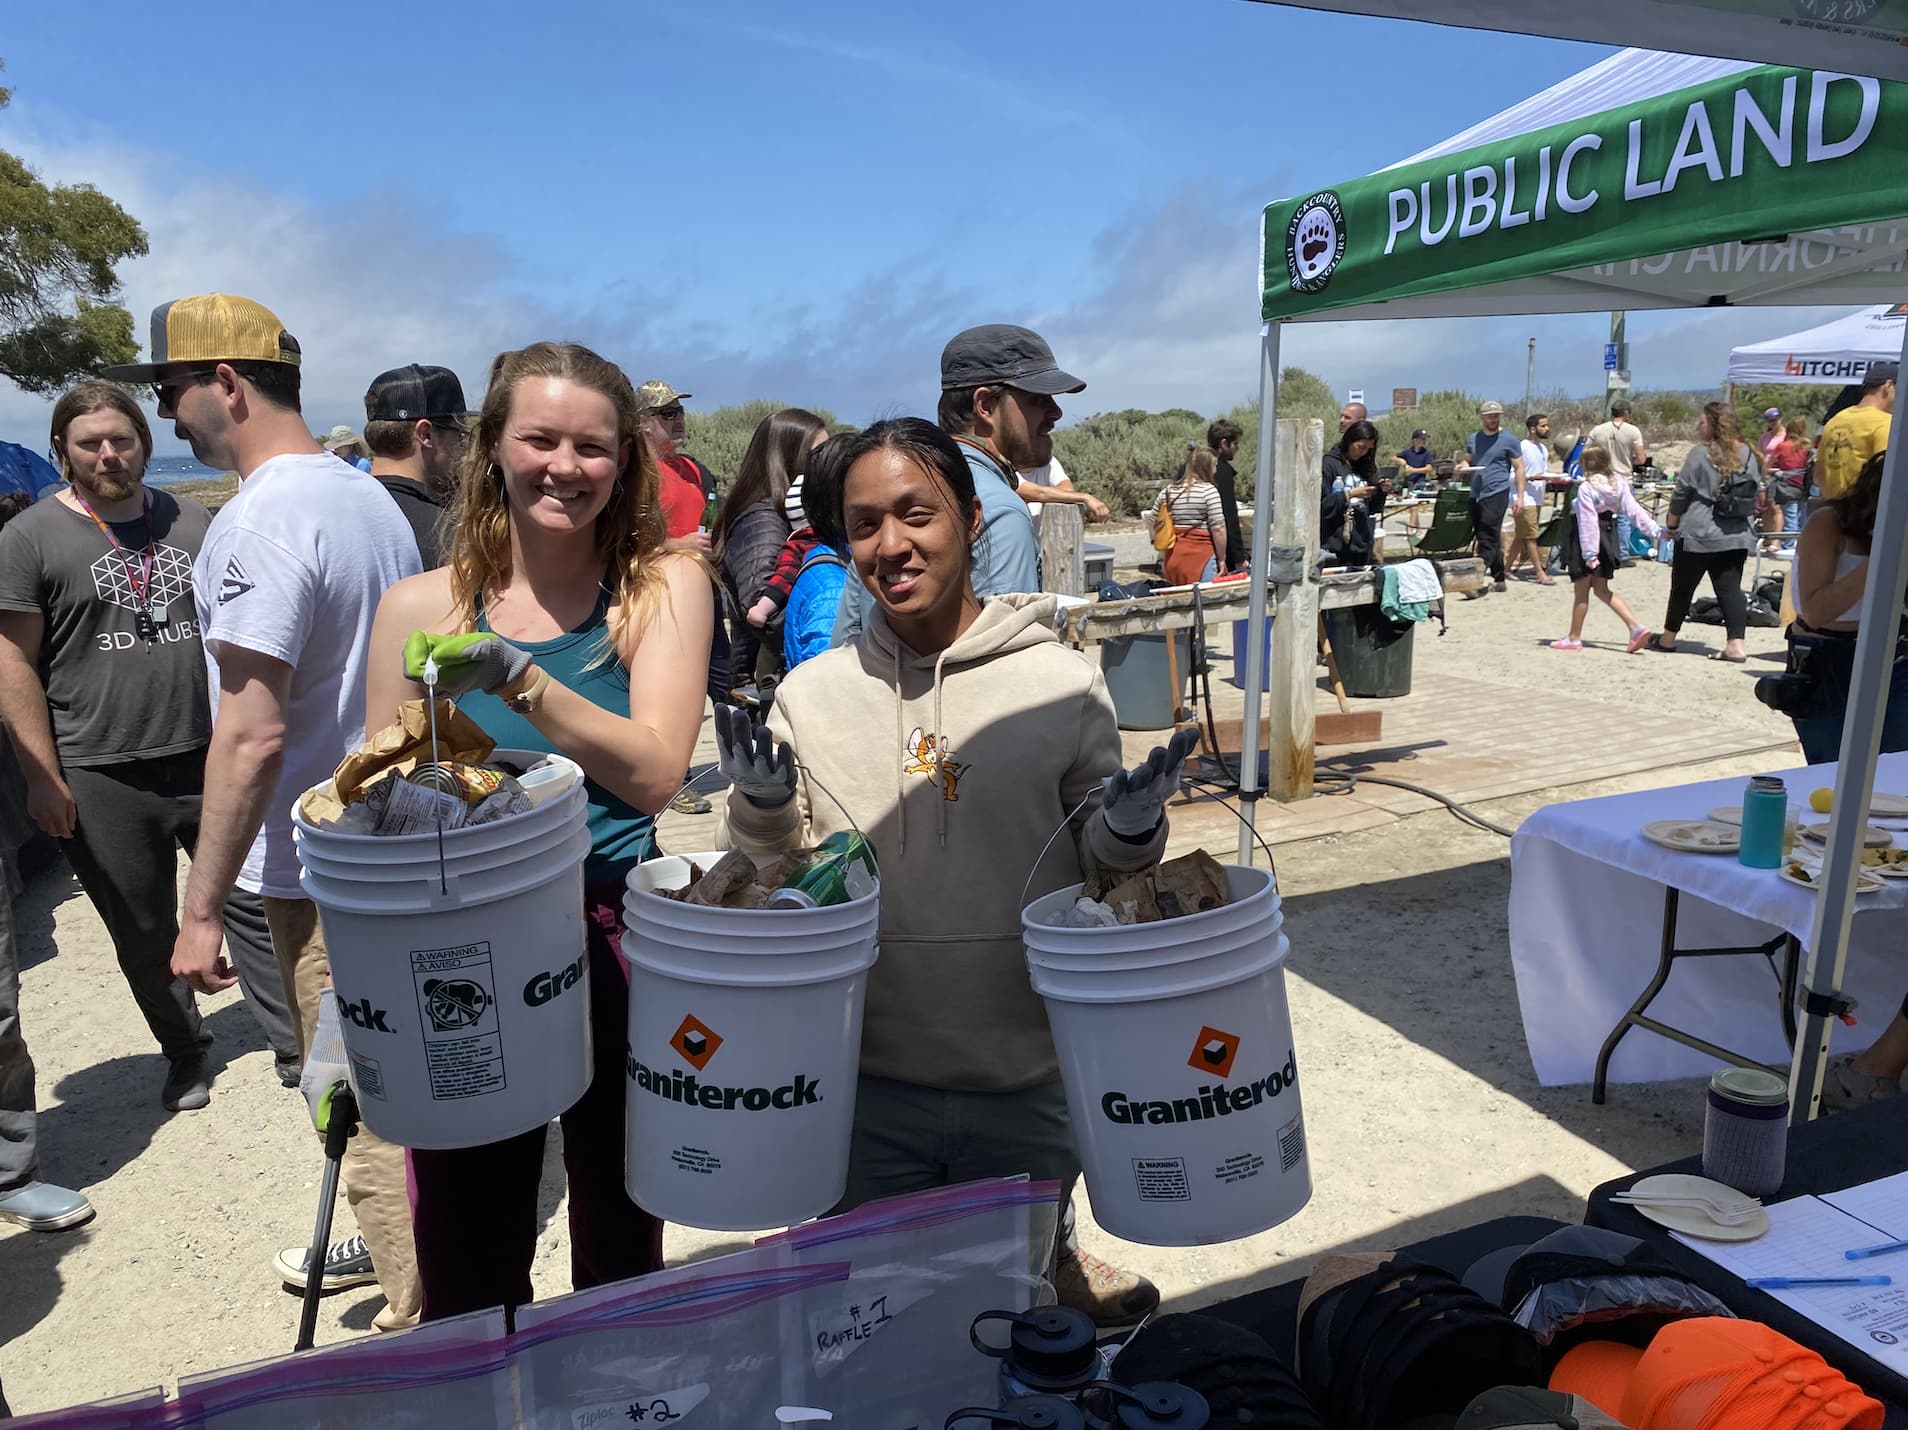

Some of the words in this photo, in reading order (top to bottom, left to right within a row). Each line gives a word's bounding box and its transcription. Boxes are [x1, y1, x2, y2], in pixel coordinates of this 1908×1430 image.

[1383, 133, 1602, 255] PUBLIC
[1624, 70, 1881, 201] LAND
[1289, 192, 1343, 236] BACKCOUNTRY
[1287, 247, 1308, 292] HUNTERS
[1308, 283, 1318, 292] &
[1315, 233, 1346, 288] ANGLERS
[1785, 353, 1900, 376] HITCHFI
[96, 631, 136, 651] 3D
[426, 946, 479, 960] WARNING
[428, 959, 461, 970] AVISO
[817, 1321, 872, 1352] RAFFLE
[577, 1407, 616, 1429] Ziploc
[625, 1399, 681, 1423] #2
